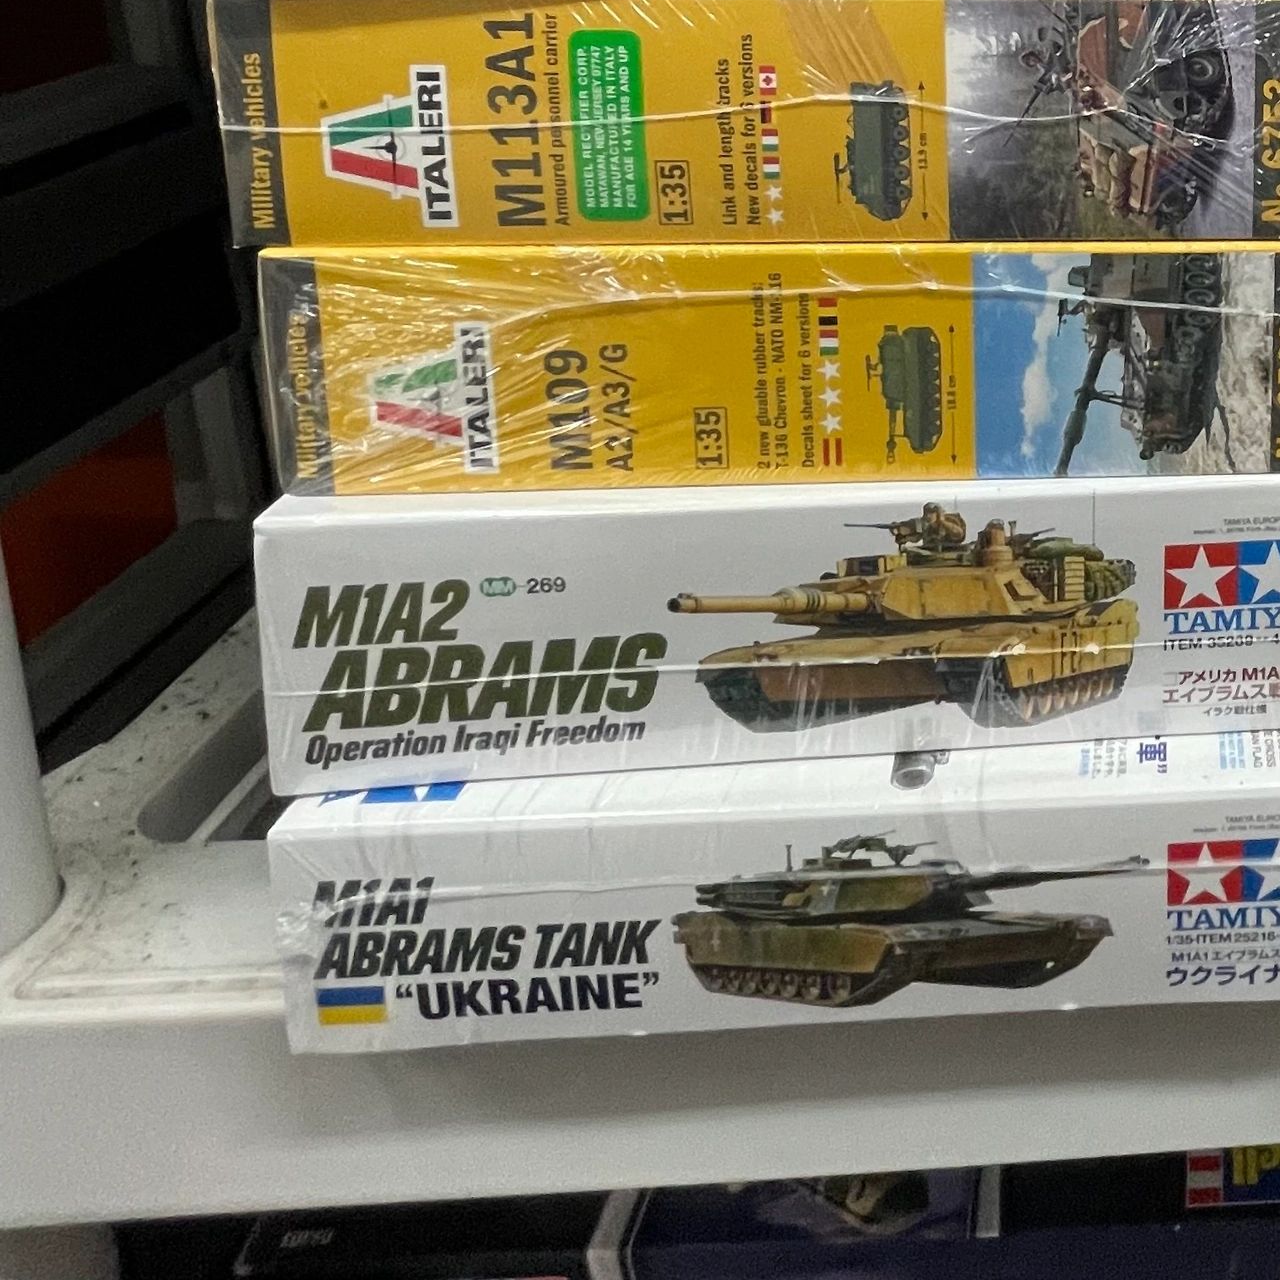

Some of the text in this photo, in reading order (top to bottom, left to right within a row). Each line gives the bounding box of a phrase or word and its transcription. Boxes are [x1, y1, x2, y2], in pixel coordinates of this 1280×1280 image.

[604, 45, 616, 82] ITALY
[618, 45, 629, 63] UP
[618, 65, 630, 93] AND
[241, 52, 274, 229] Military vehicles
[416, 71, 453, 221] ITALERI
[484, 12, 547, 227] M113A1
[541, 12, 571, 227] Armoured personnel carrier
[715, 58, 737, 225] Link and length tracks
[738, 33, 761, 226] New decals for versions
[583, 164, 596, 208] MODEL
[660, 163, 689, 223] 1:35
[752, 329, 769, 375] rubber
[771, 328, 788, 432] Chevron NATO
[796, 292, 815, 468] Decals sheet for versions
[460, 325, 495, 468] ITALERI
[543, 348, 594, 471] M109
[598, 343, 639, 472] A2/A3/G
[695, 410, 724, 467] 1:35
[292, 577, 567, 649] M1A2 269
[302, 632, 668, 733] ABRAMS
[1178, 669, 1237, 686] アメリカ
[304, 719, 647, 770] Operation Iraqi Freedom
[312, 876, 435, 929] M1A1
[314, 919, 663, 980] ABRAMS TANK
